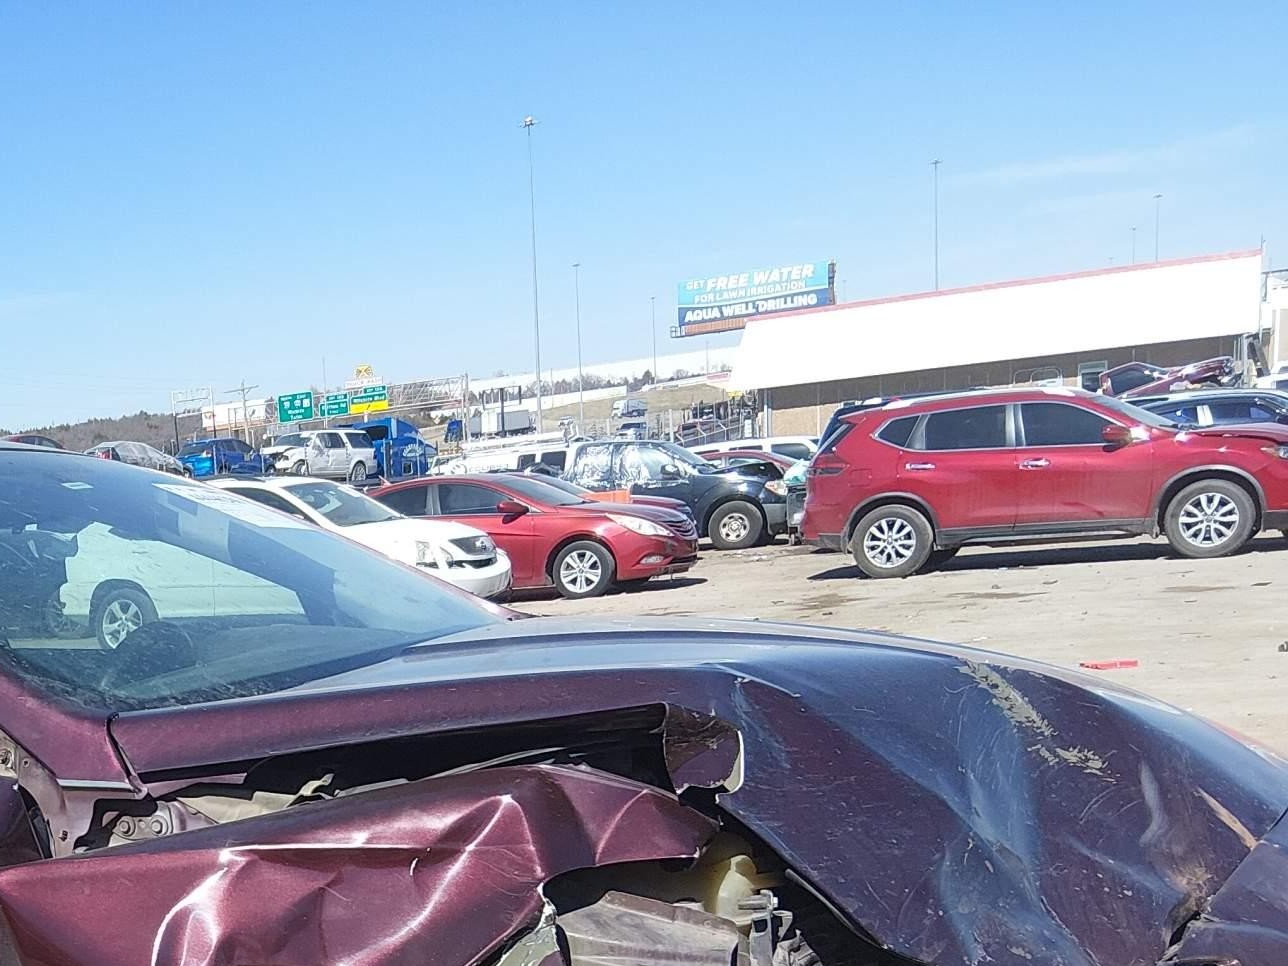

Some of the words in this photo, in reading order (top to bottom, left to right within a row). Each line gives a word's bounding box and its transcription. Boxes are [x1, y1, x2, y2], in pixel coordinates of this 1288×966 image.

[686, 281, 705, 291] GET
[706, 273, 749, 291] FREE
[754, 263, 815, 285] WATER
[695, 294, 714, 304] FOR
[715, 290, 747, 302] LAWN
[748, 280, 806, 298] IRRIGATION
[684, 308, 721, 322] AQUA
[722, 302, 756, 318] WELL
[757, 294, 818, 313] DRILLING
